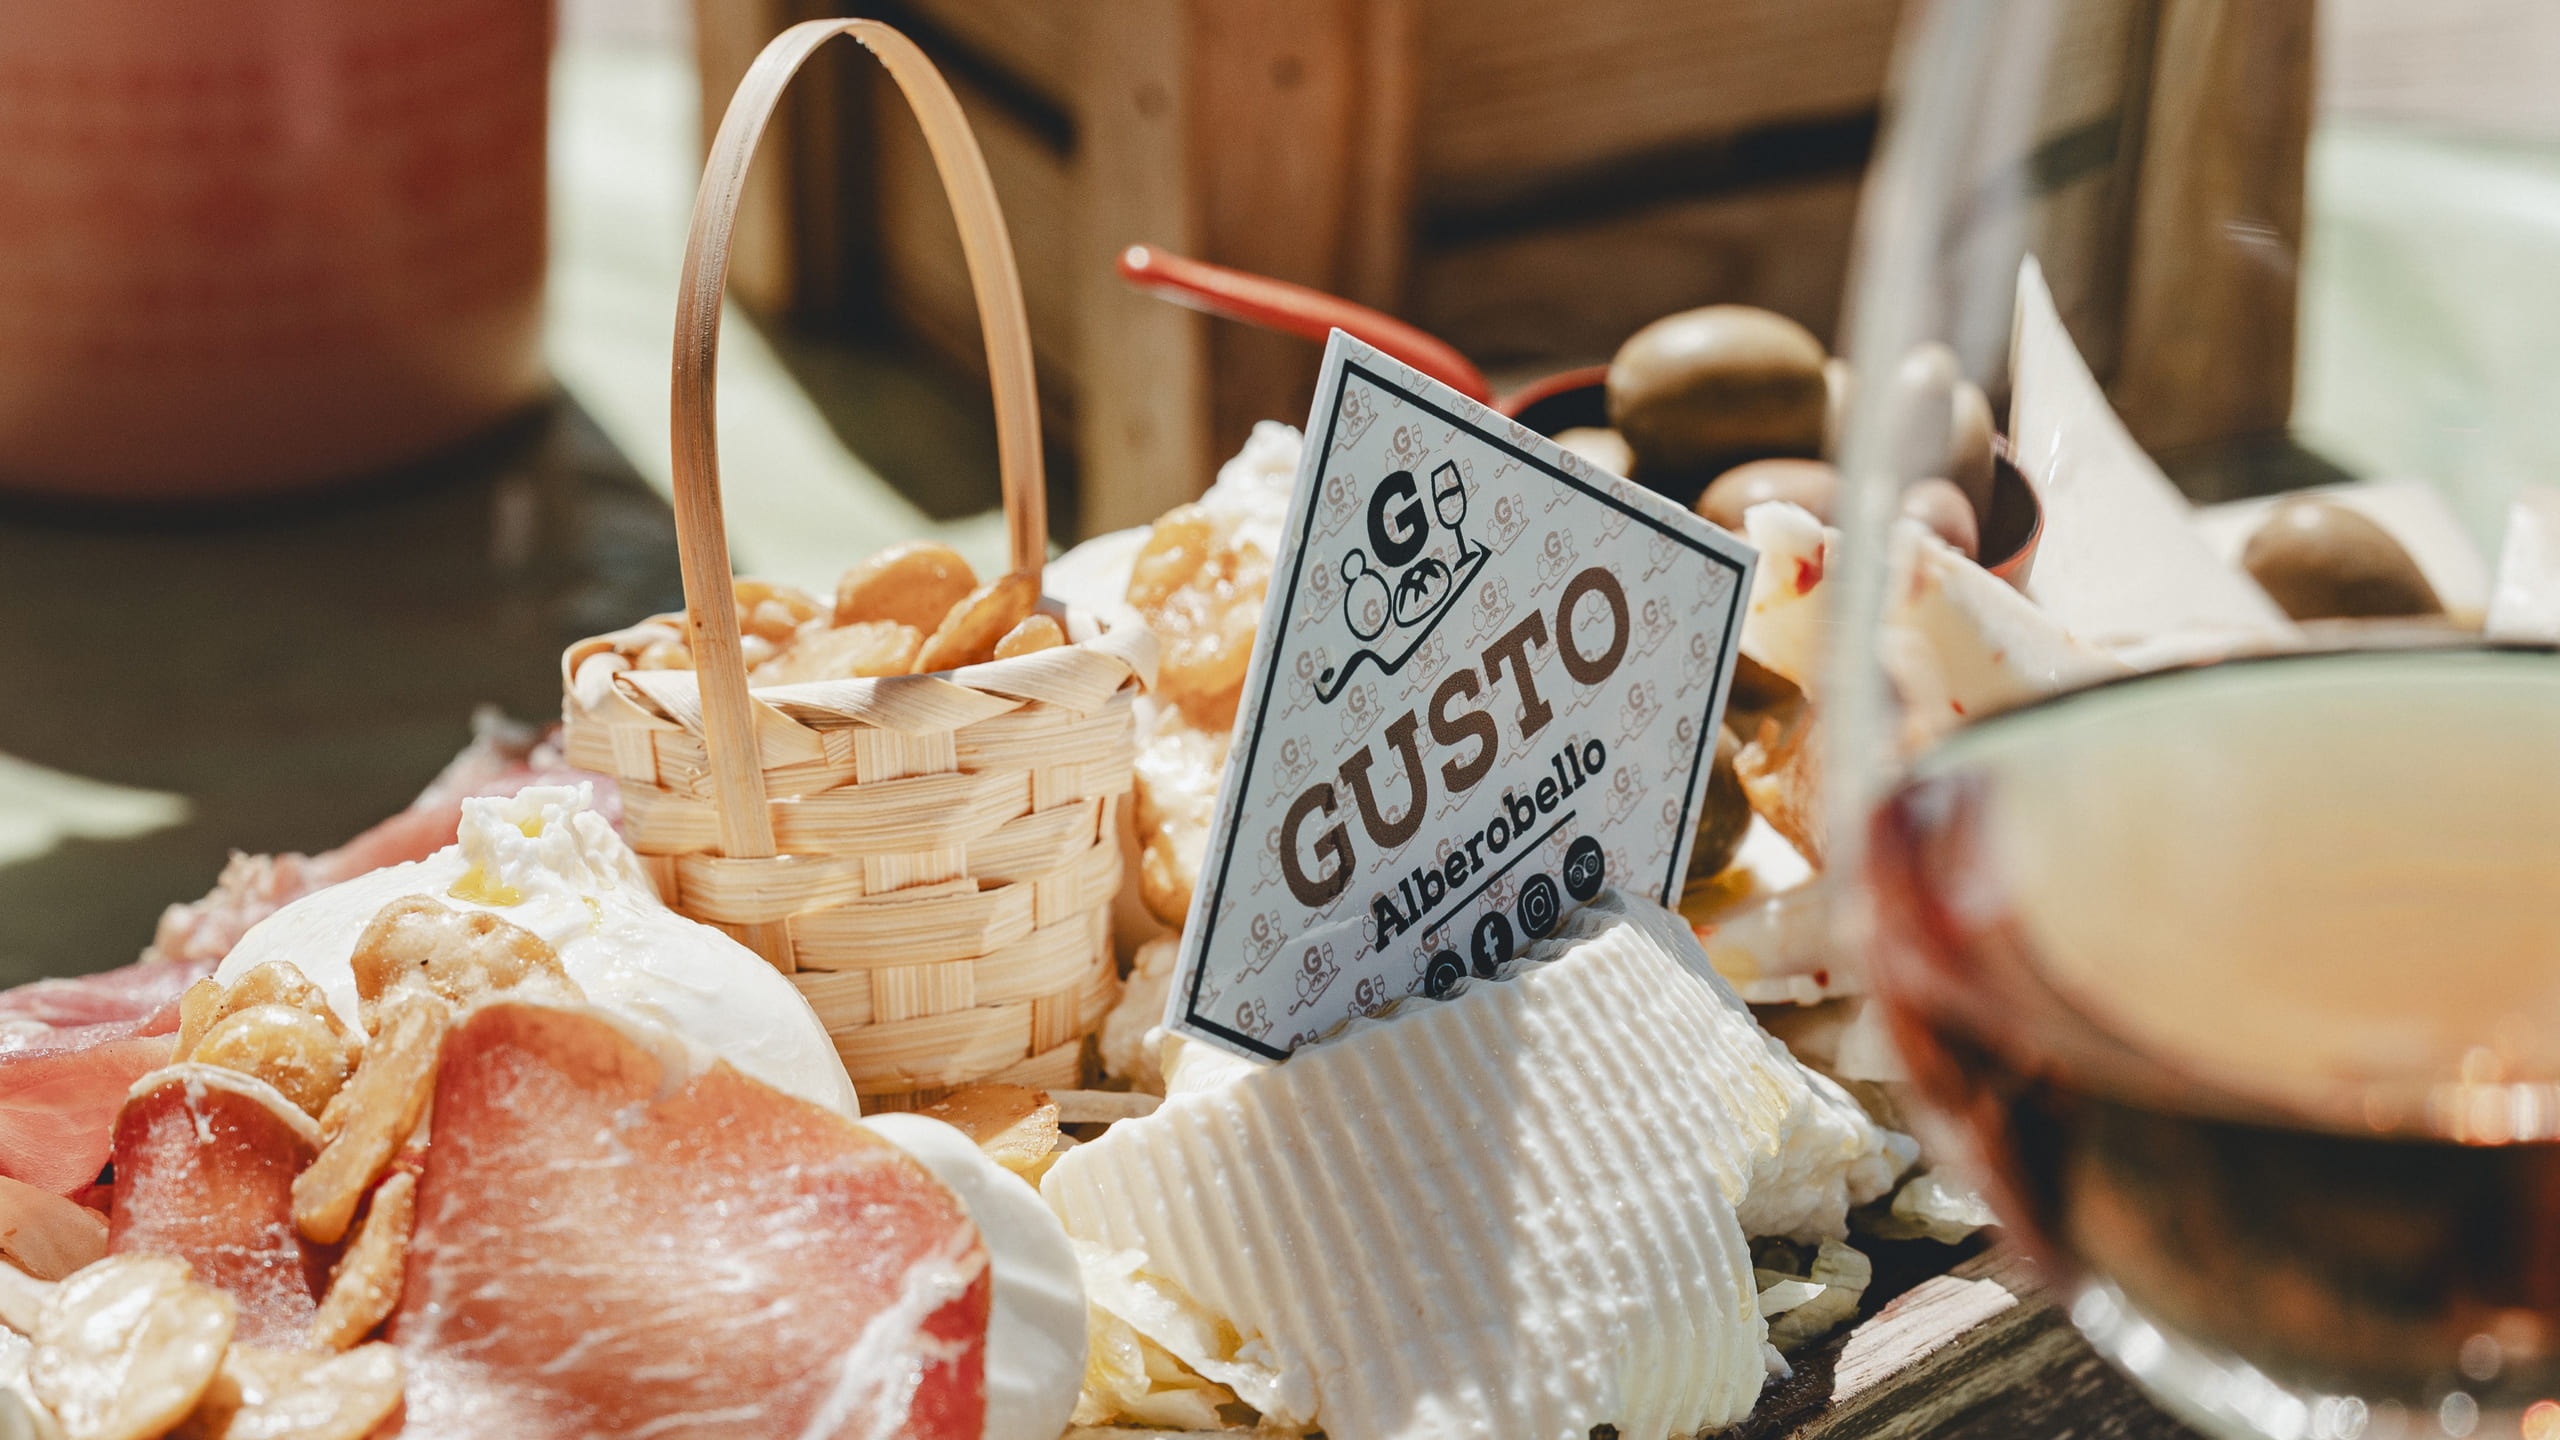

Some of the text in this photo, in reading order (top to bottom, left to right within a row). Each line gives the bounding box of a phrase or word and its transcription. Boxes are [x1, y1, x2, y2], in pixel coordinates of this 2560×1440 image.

[1367, 470, 1429, 568] G
[1280, 566, 1630, 908] GUSTO
[1372, 739, 1606, 953] Alberobello
